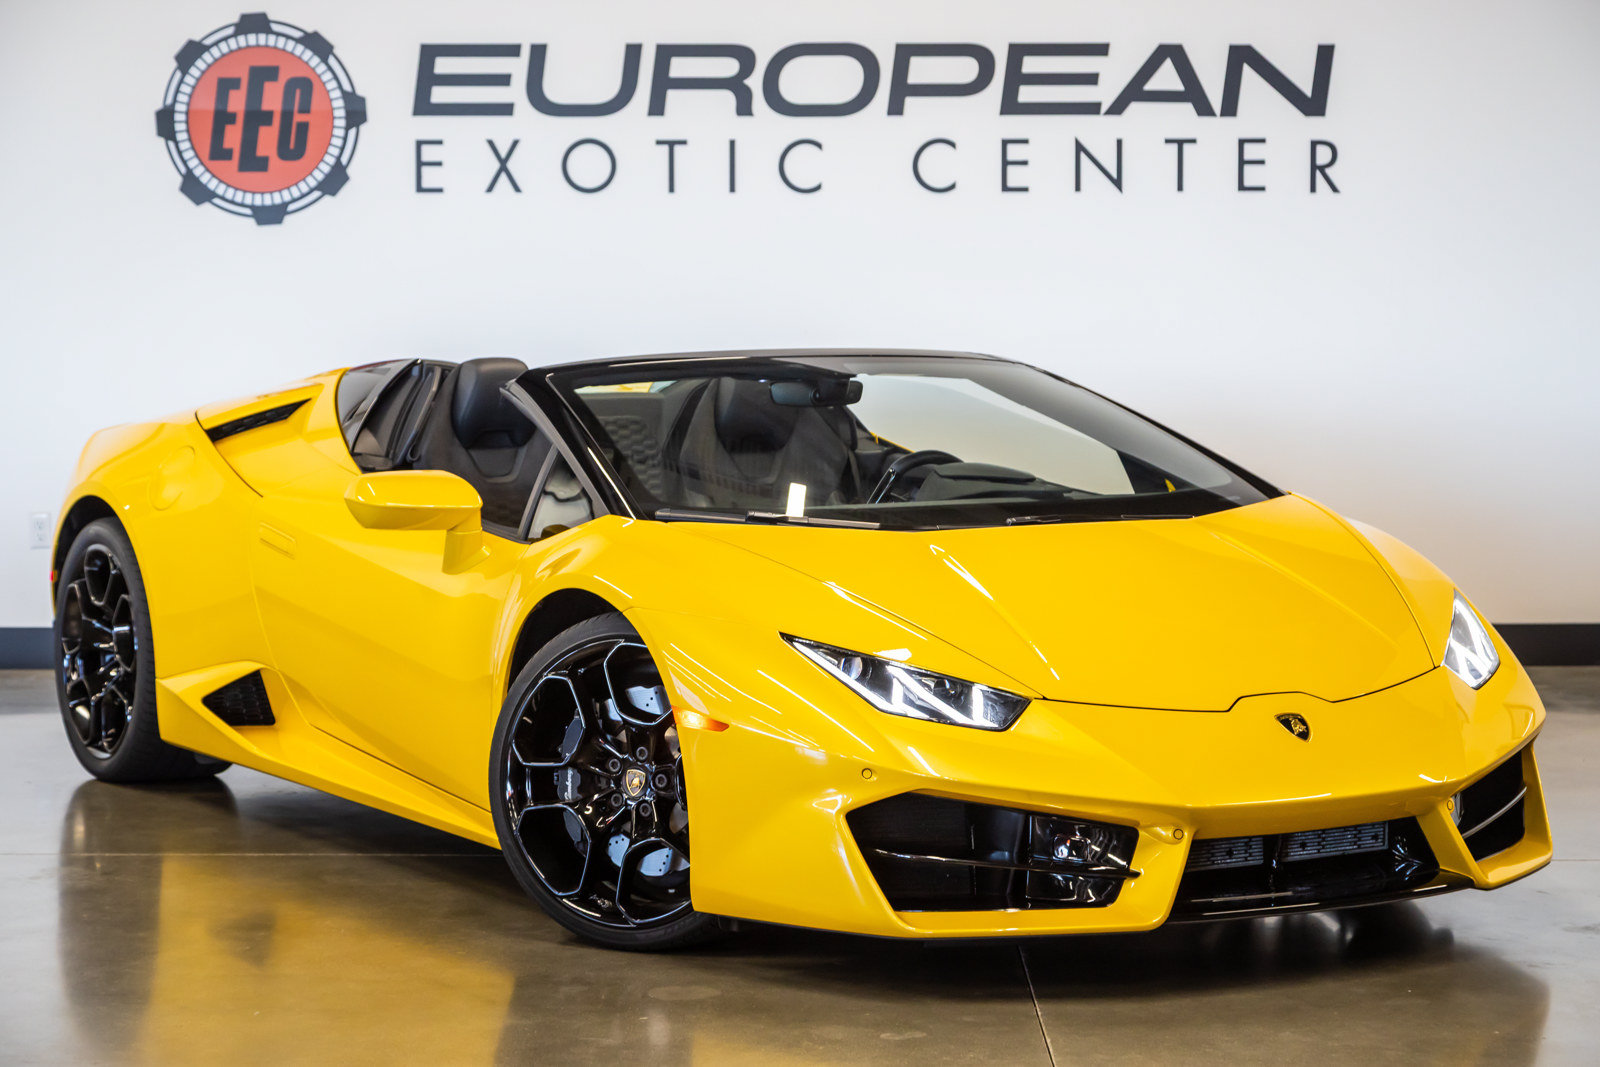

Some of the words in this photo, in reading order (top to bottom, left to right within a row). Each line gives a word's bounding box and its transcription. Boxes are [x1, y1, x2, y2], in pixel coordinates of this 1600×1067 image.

[412, 43, 1336, 117] EUROPEAN
[208, 65, 314, 173] EEC
[415, 139, 823, 194] EXOTIC
[912, 138, 1340, 194] CENTER
